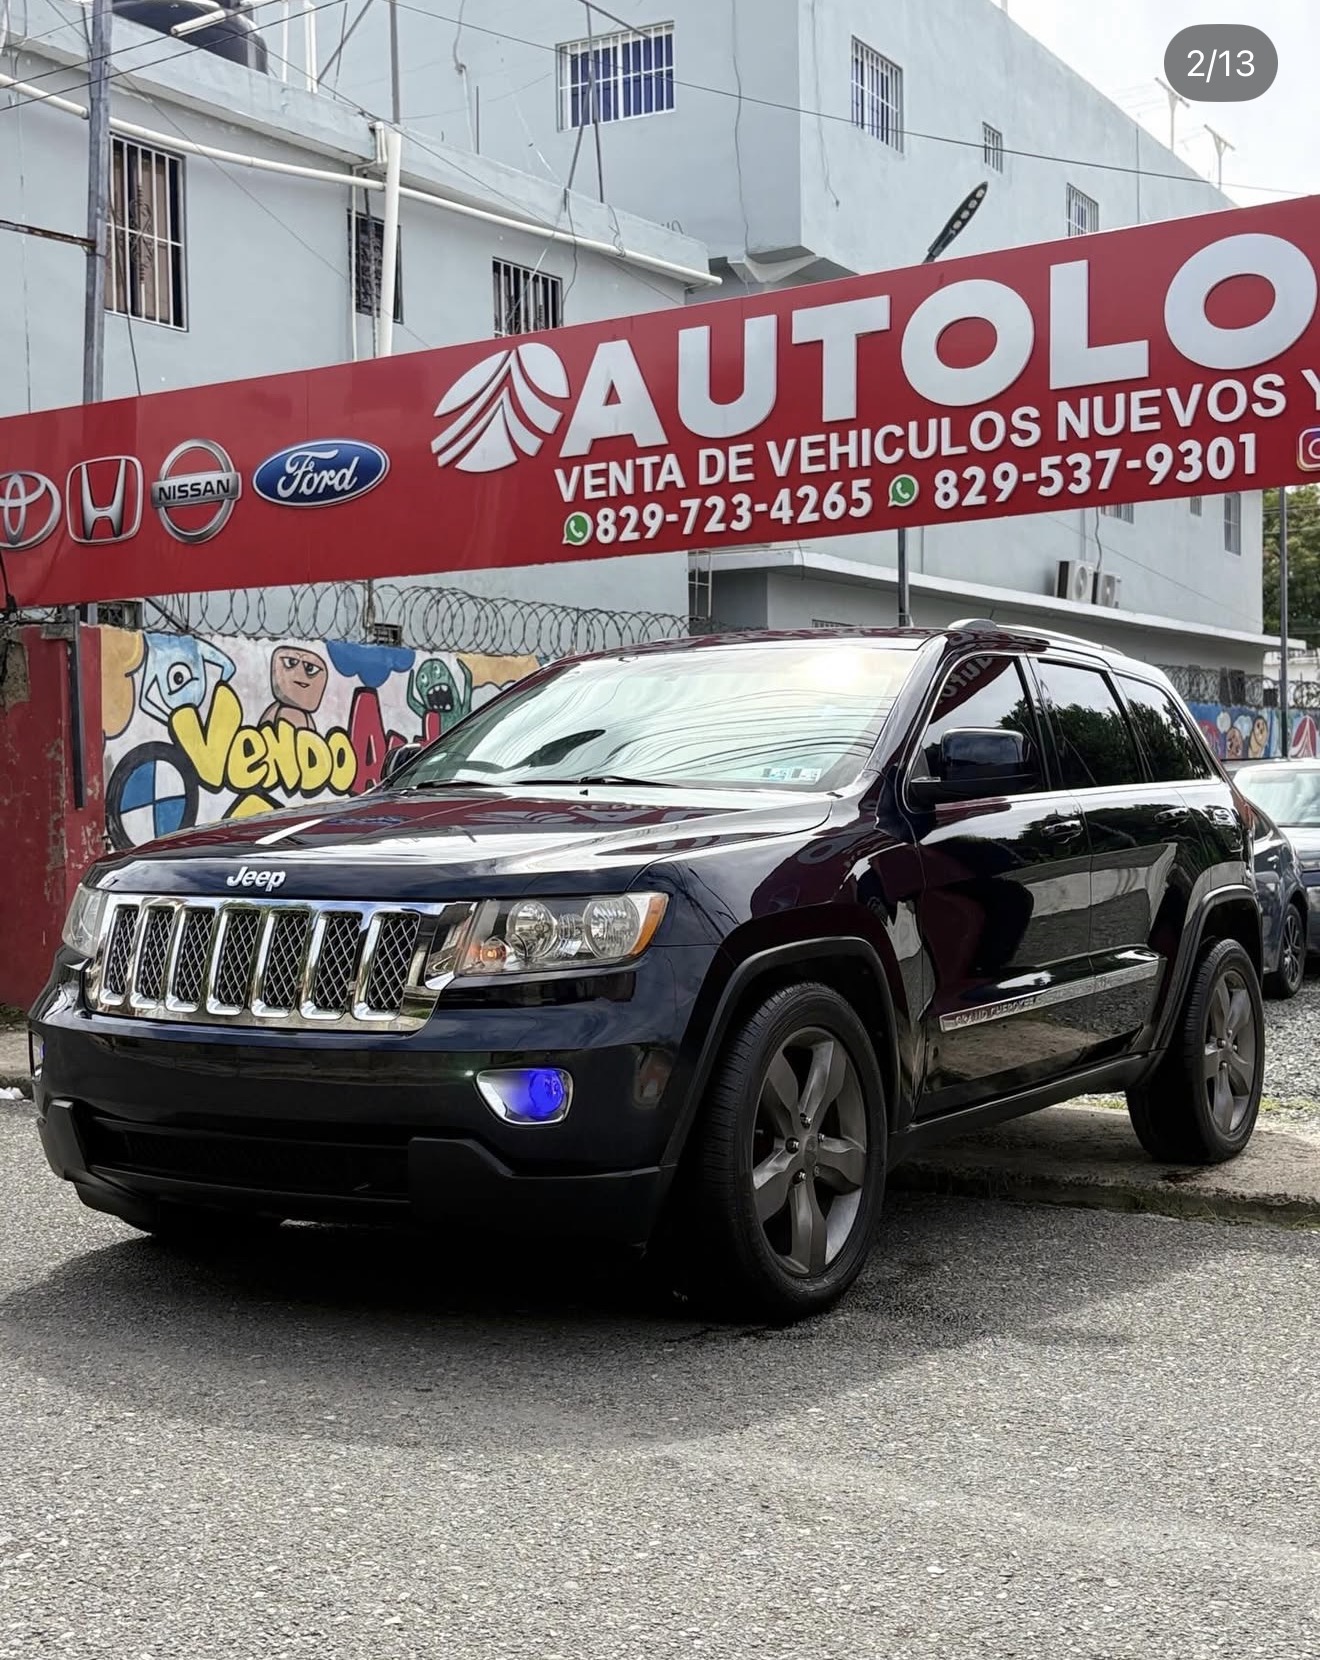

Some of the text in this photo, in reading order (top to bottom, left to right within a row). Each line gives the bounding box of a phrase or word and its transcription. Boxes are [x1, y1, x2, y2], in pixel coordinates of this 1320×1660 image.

[559, 233, 1318, 458] AUTOLO
[277, 449, 360, 498] Ford
[554, 453, 686, 503] VENTA
[698, 444, 755, 486] DE
[766, 405, 1042, 478] VEHICULOS
[1056, 373, 1287, 443] NUEVOS
[158, 478, 231, 501] NISSAN
[596, 432, 1257, 544] 829-723-4265 829-537-9301
[226, 866, 287, 892] Jeep
